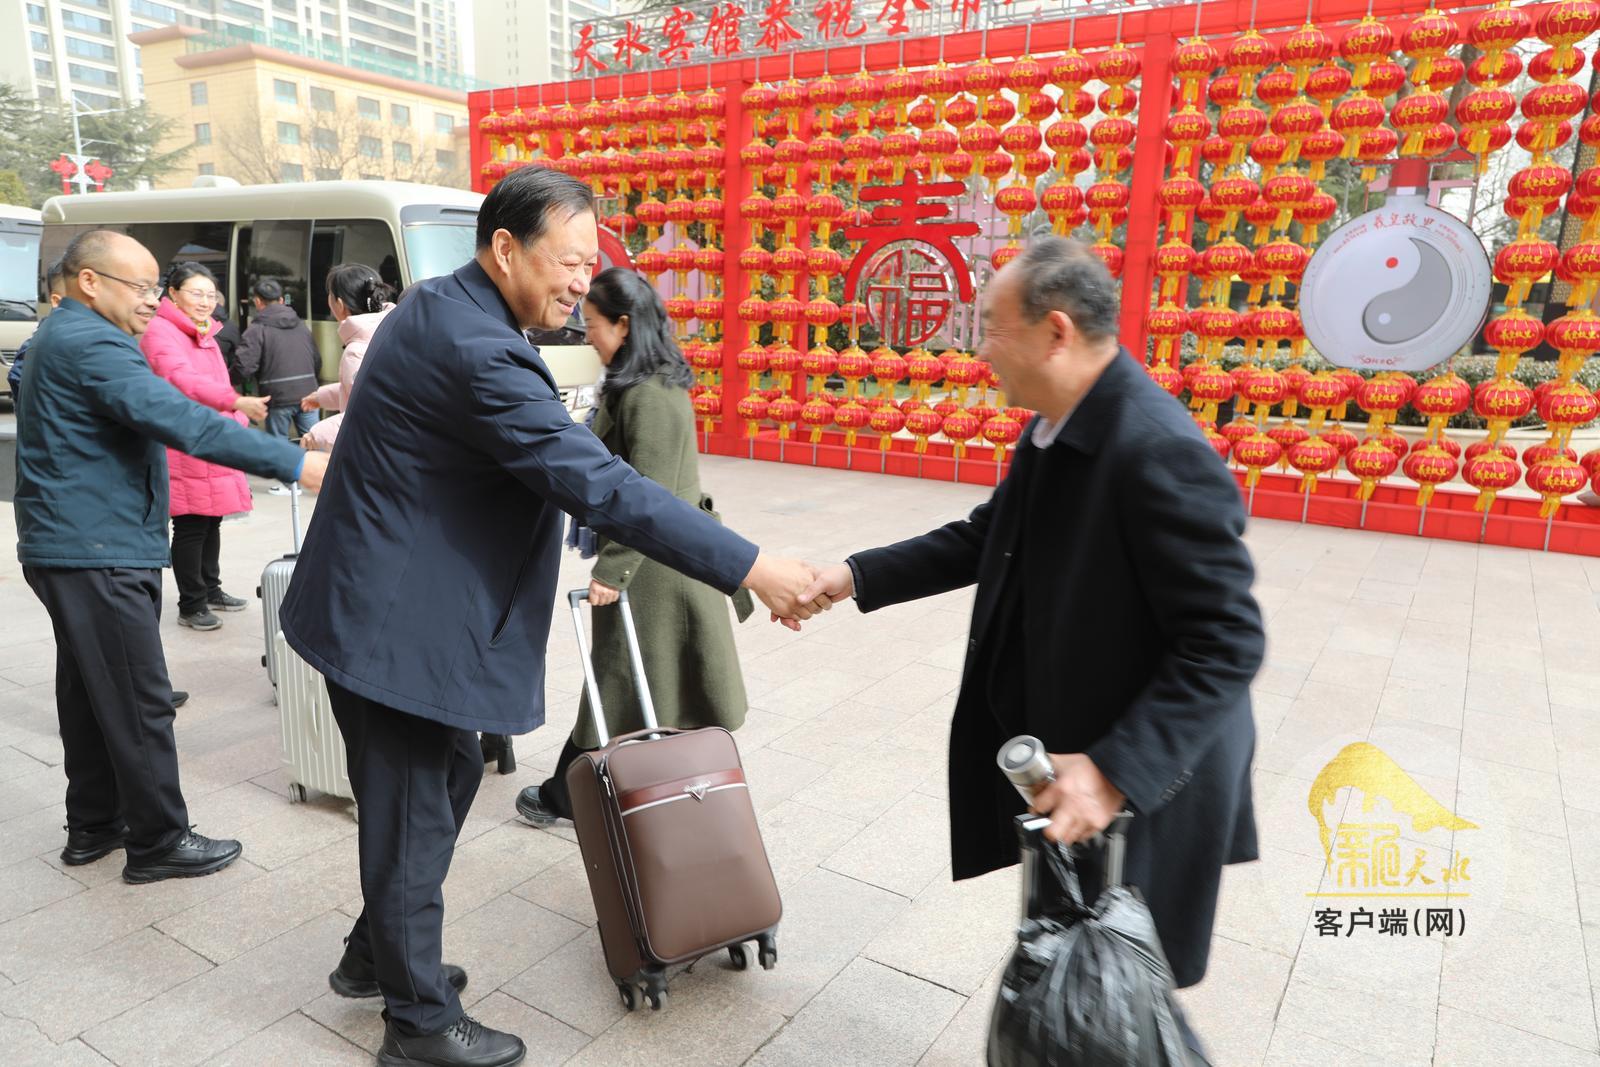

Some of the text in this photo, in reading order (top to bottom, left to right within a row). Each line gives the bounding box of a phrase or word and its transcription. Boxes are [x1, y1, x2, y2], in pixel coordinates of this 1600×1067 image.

[573, 0, 1136, 72] 天水宾馆恭祝全市
[866, 249, 953, 346] 福
